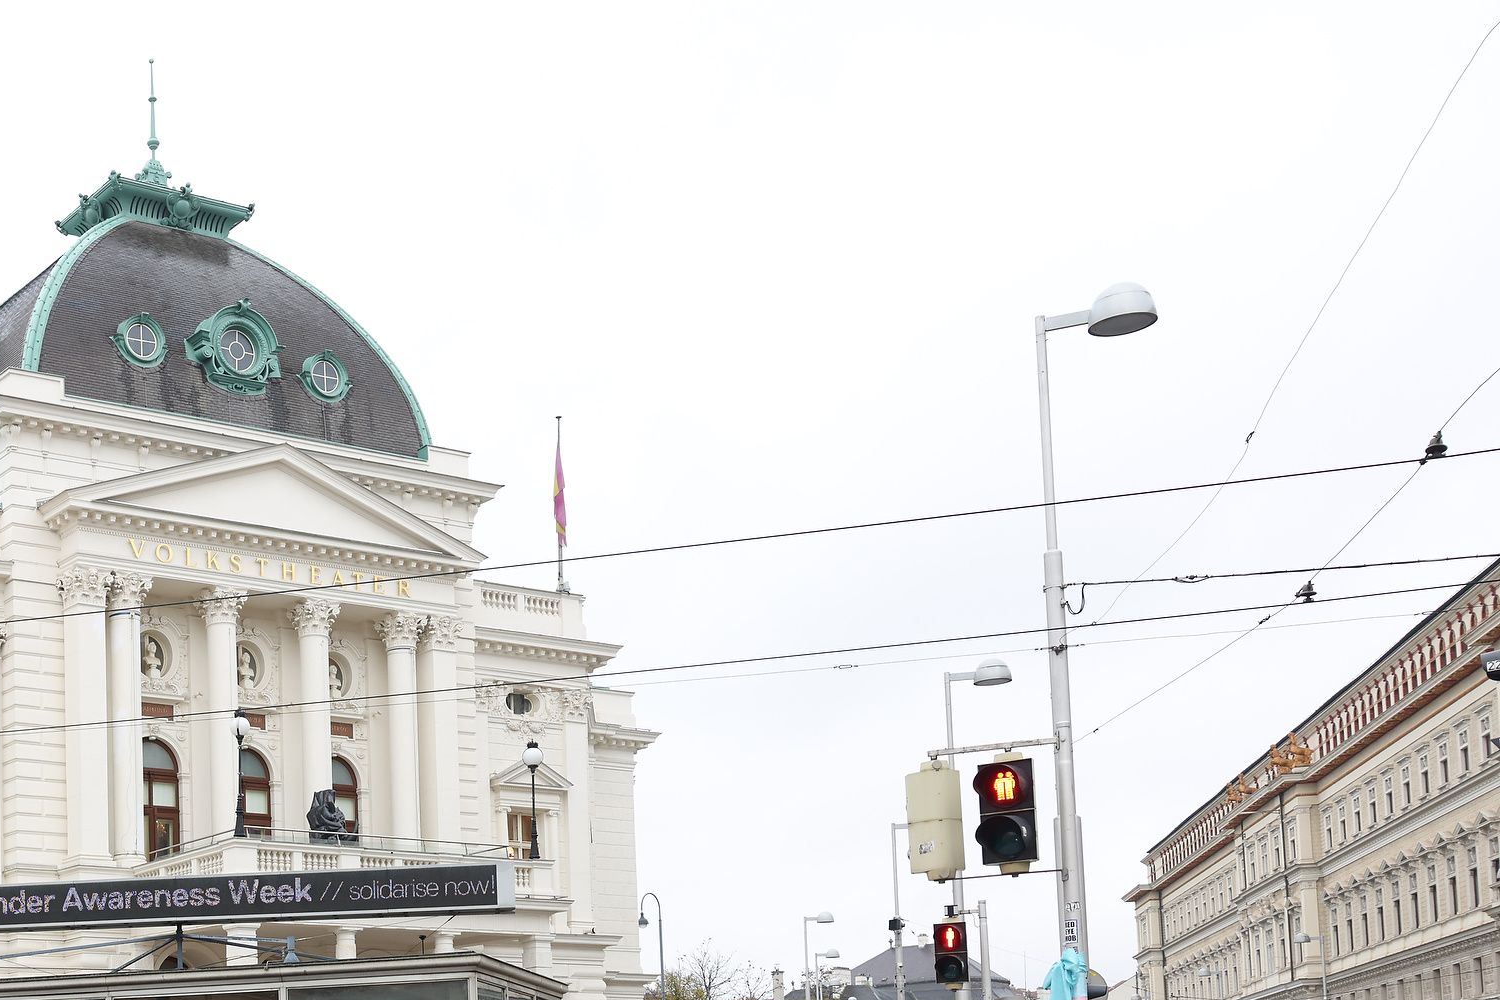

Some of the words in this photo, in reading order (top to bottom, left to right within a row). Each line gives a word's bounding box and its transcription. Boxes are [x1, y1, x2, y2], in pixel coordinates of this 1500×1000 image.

[128, 538, 412, 598] VOLKSTHEATER
[62, 885, 221, 912] Awareness
[228, 877, 313, 904] Week
[349, 879, 439, 901] solidarise
[444, 874, 497, 896] now!
